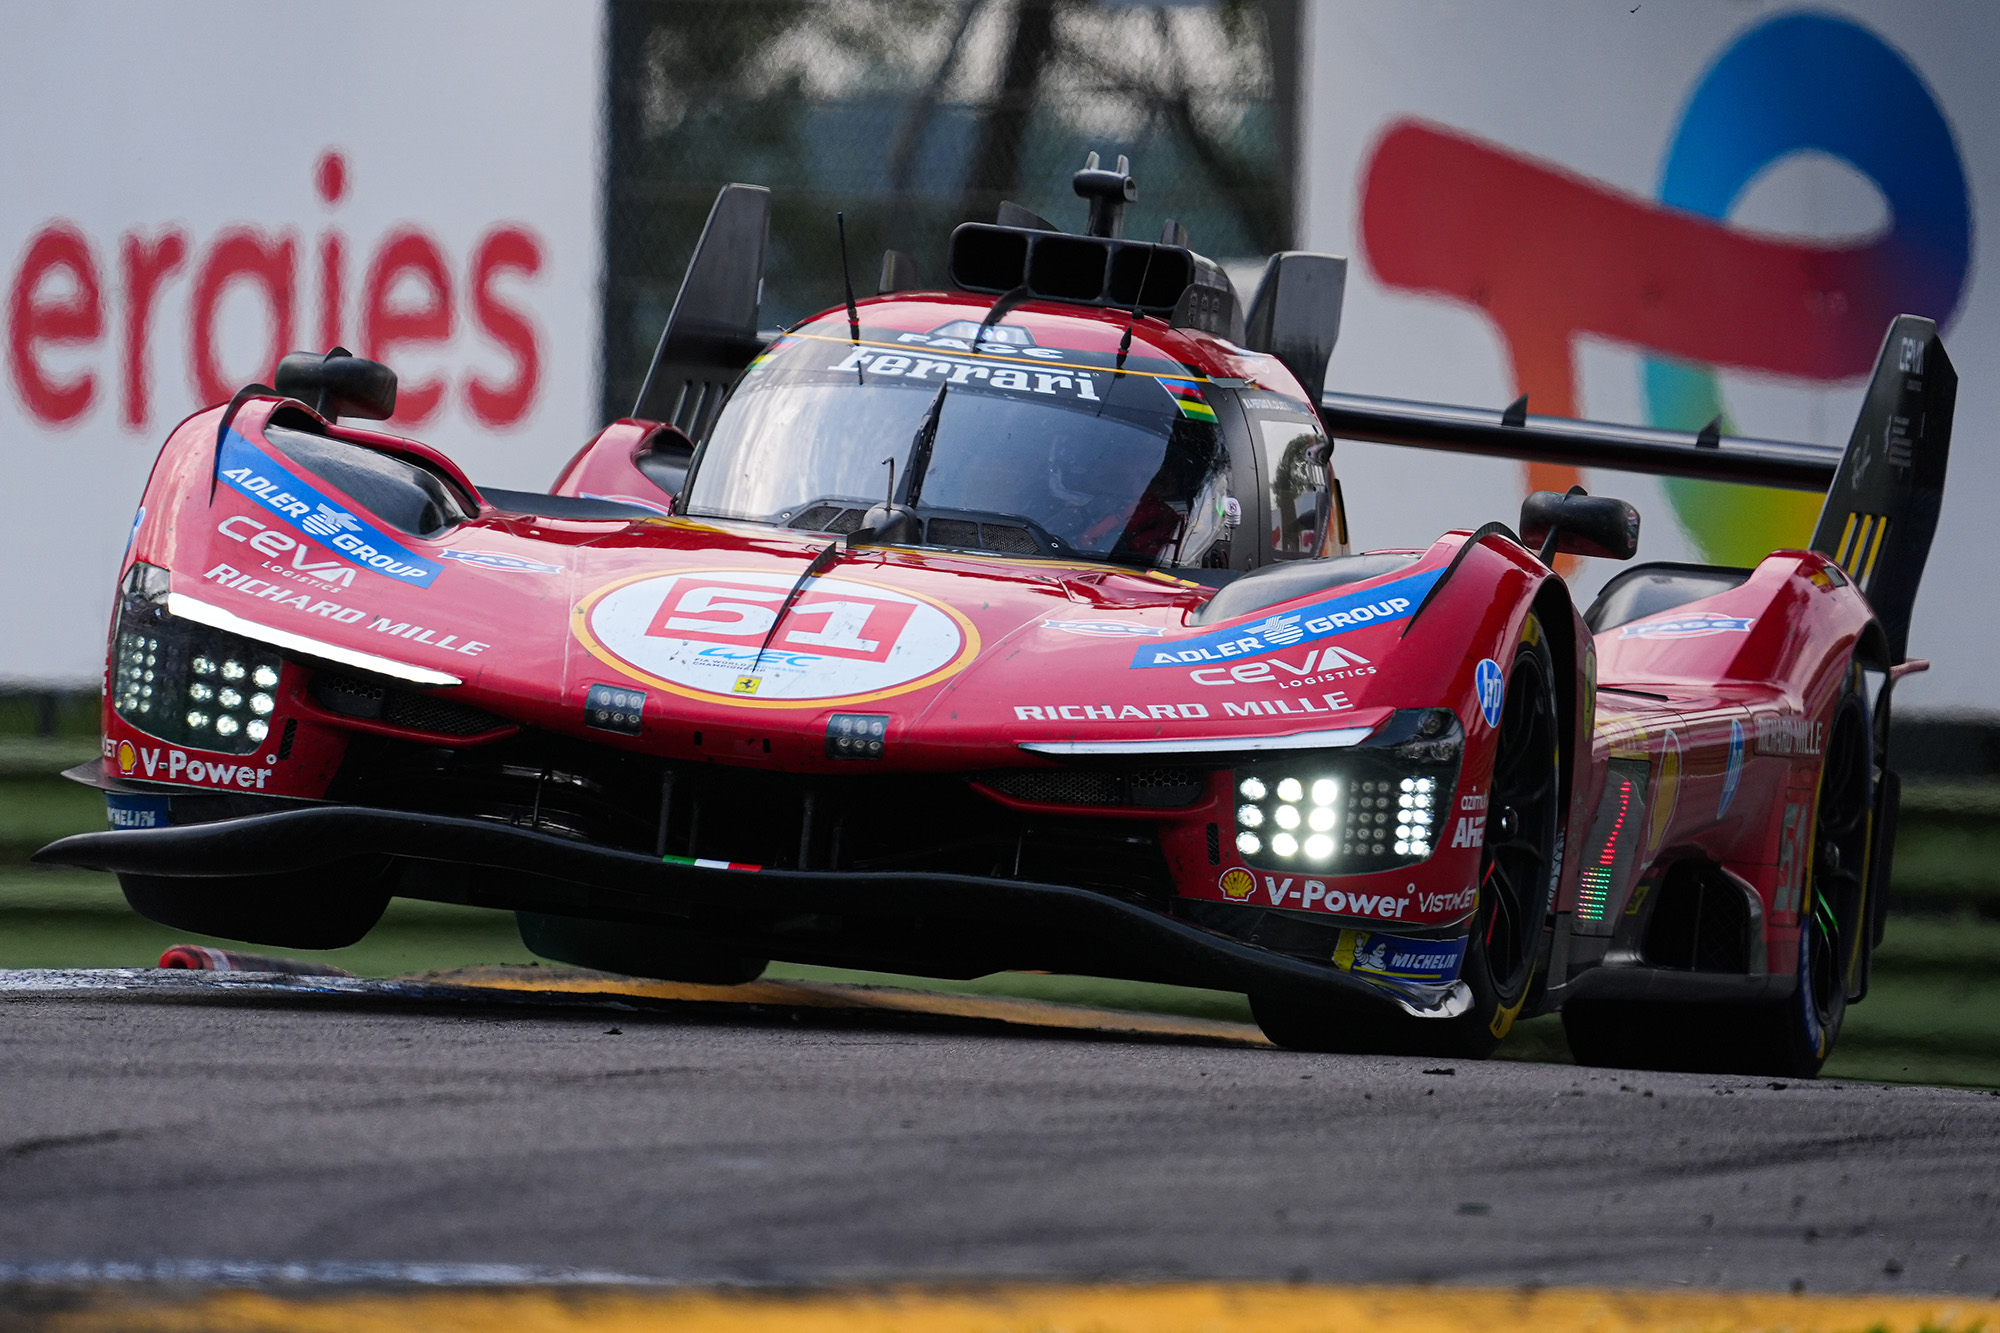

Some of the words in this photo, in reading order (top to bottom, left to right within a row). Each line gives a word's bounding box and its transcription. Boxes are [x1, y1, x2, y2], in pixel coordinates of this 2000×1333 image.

[828, 346, 1101, 401] Ferrari
[222, 467, 310, 519] ADLER
[331, 533, 428, 578] GROUP
[261, 560, 343, 594] LOGISTICS
[203, 562, 367, 624] RICHARD
[366, 617, 491, 656] MILLE
[664, 586, 882, 653] 51
[1152, 637, 1264, 665] ADLER
[1304, 596, 1410, 634] GROUP
[1278, 665, 1378, 690] LOGISTICS
[1013, 703, 1208, 721] RICHARD
[1225, 691, 1354, 718] MILLE
[140, 747, 273, 789] V-Power
[1264, 875, 1410, 918] V-Power
[1390, 952, 1458, 970] MICHELIN
